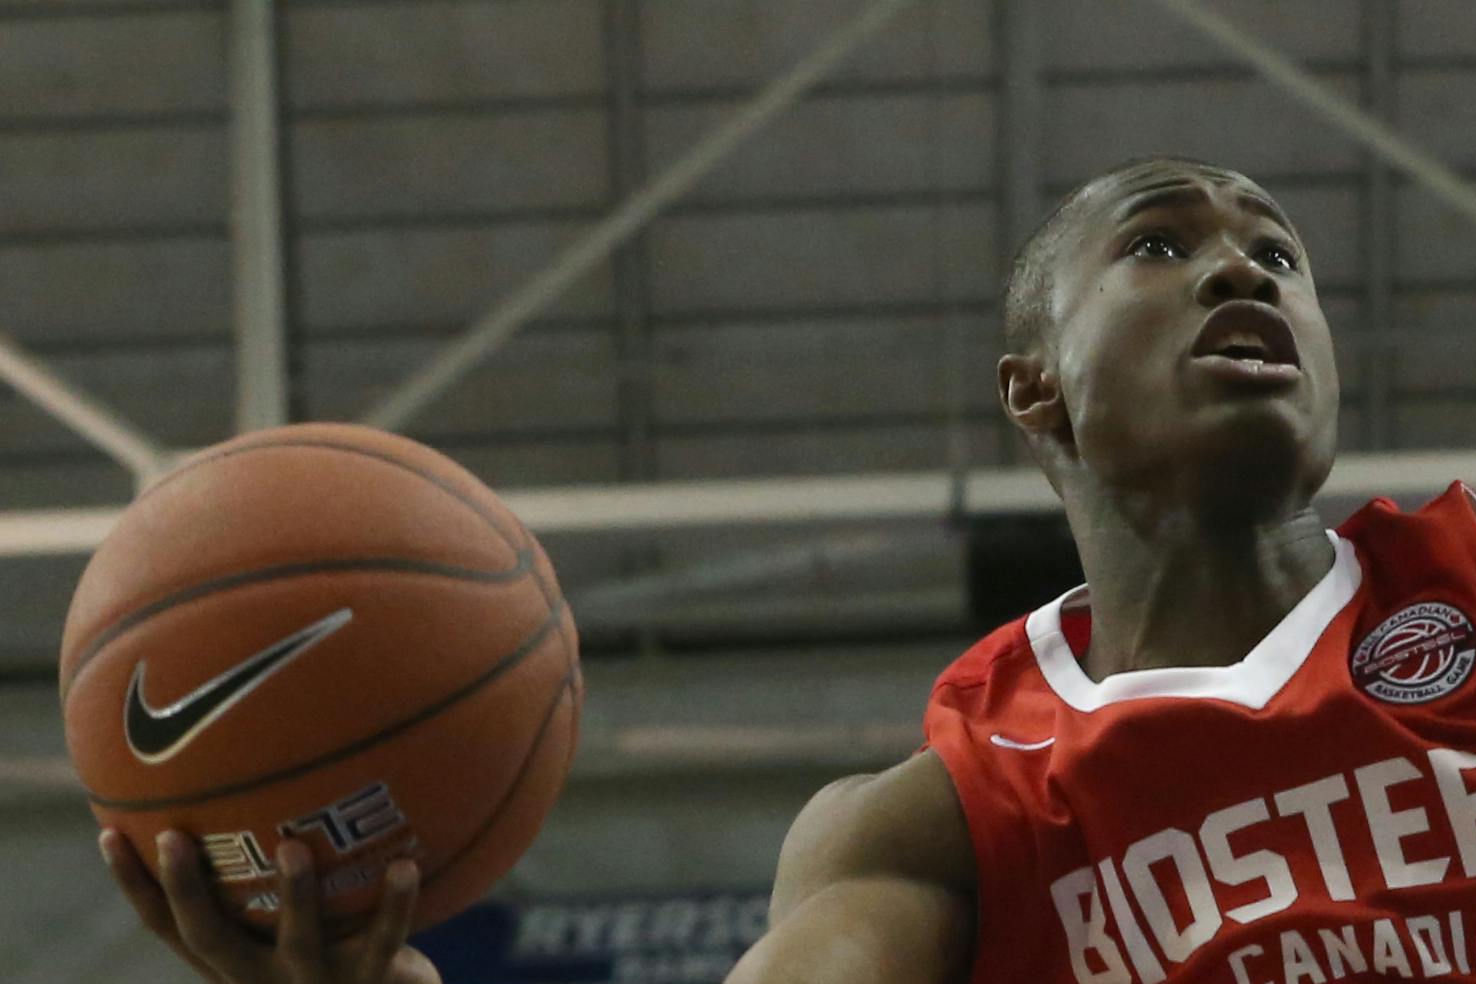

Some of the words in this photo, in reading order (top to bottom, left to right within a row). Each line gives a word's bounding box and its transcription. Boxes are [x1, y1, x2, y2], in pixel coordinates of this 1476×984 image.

[1373, 684, 1444, 700] BASKETBALL
[202, 781, 406, 882] ELTE
[513, 898, 773, 956] RYERSO
